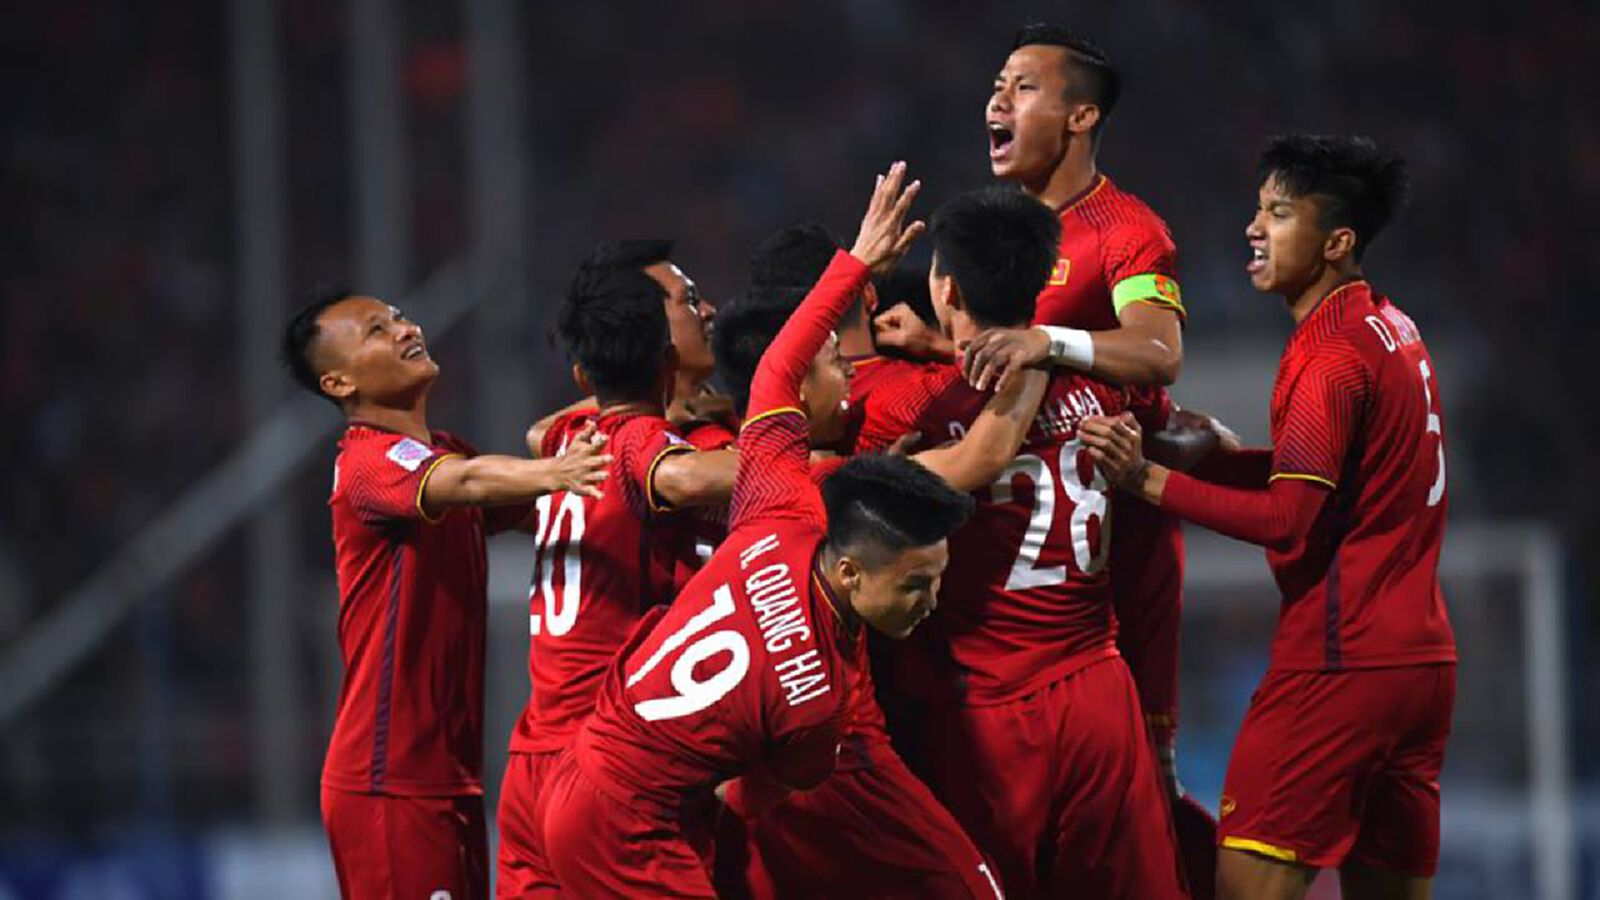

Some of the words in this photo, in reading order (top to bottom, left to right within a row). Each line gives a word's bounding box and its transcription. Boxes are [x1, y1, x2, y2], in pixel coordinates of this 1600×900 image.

[739, 533, 781, 570] N.
[991, 437, 1112, 592] 28
[626, 582, 751, 722] 19
[745, 562, 811, 654] QUANG
[774, 649, 831, 707] HAI
